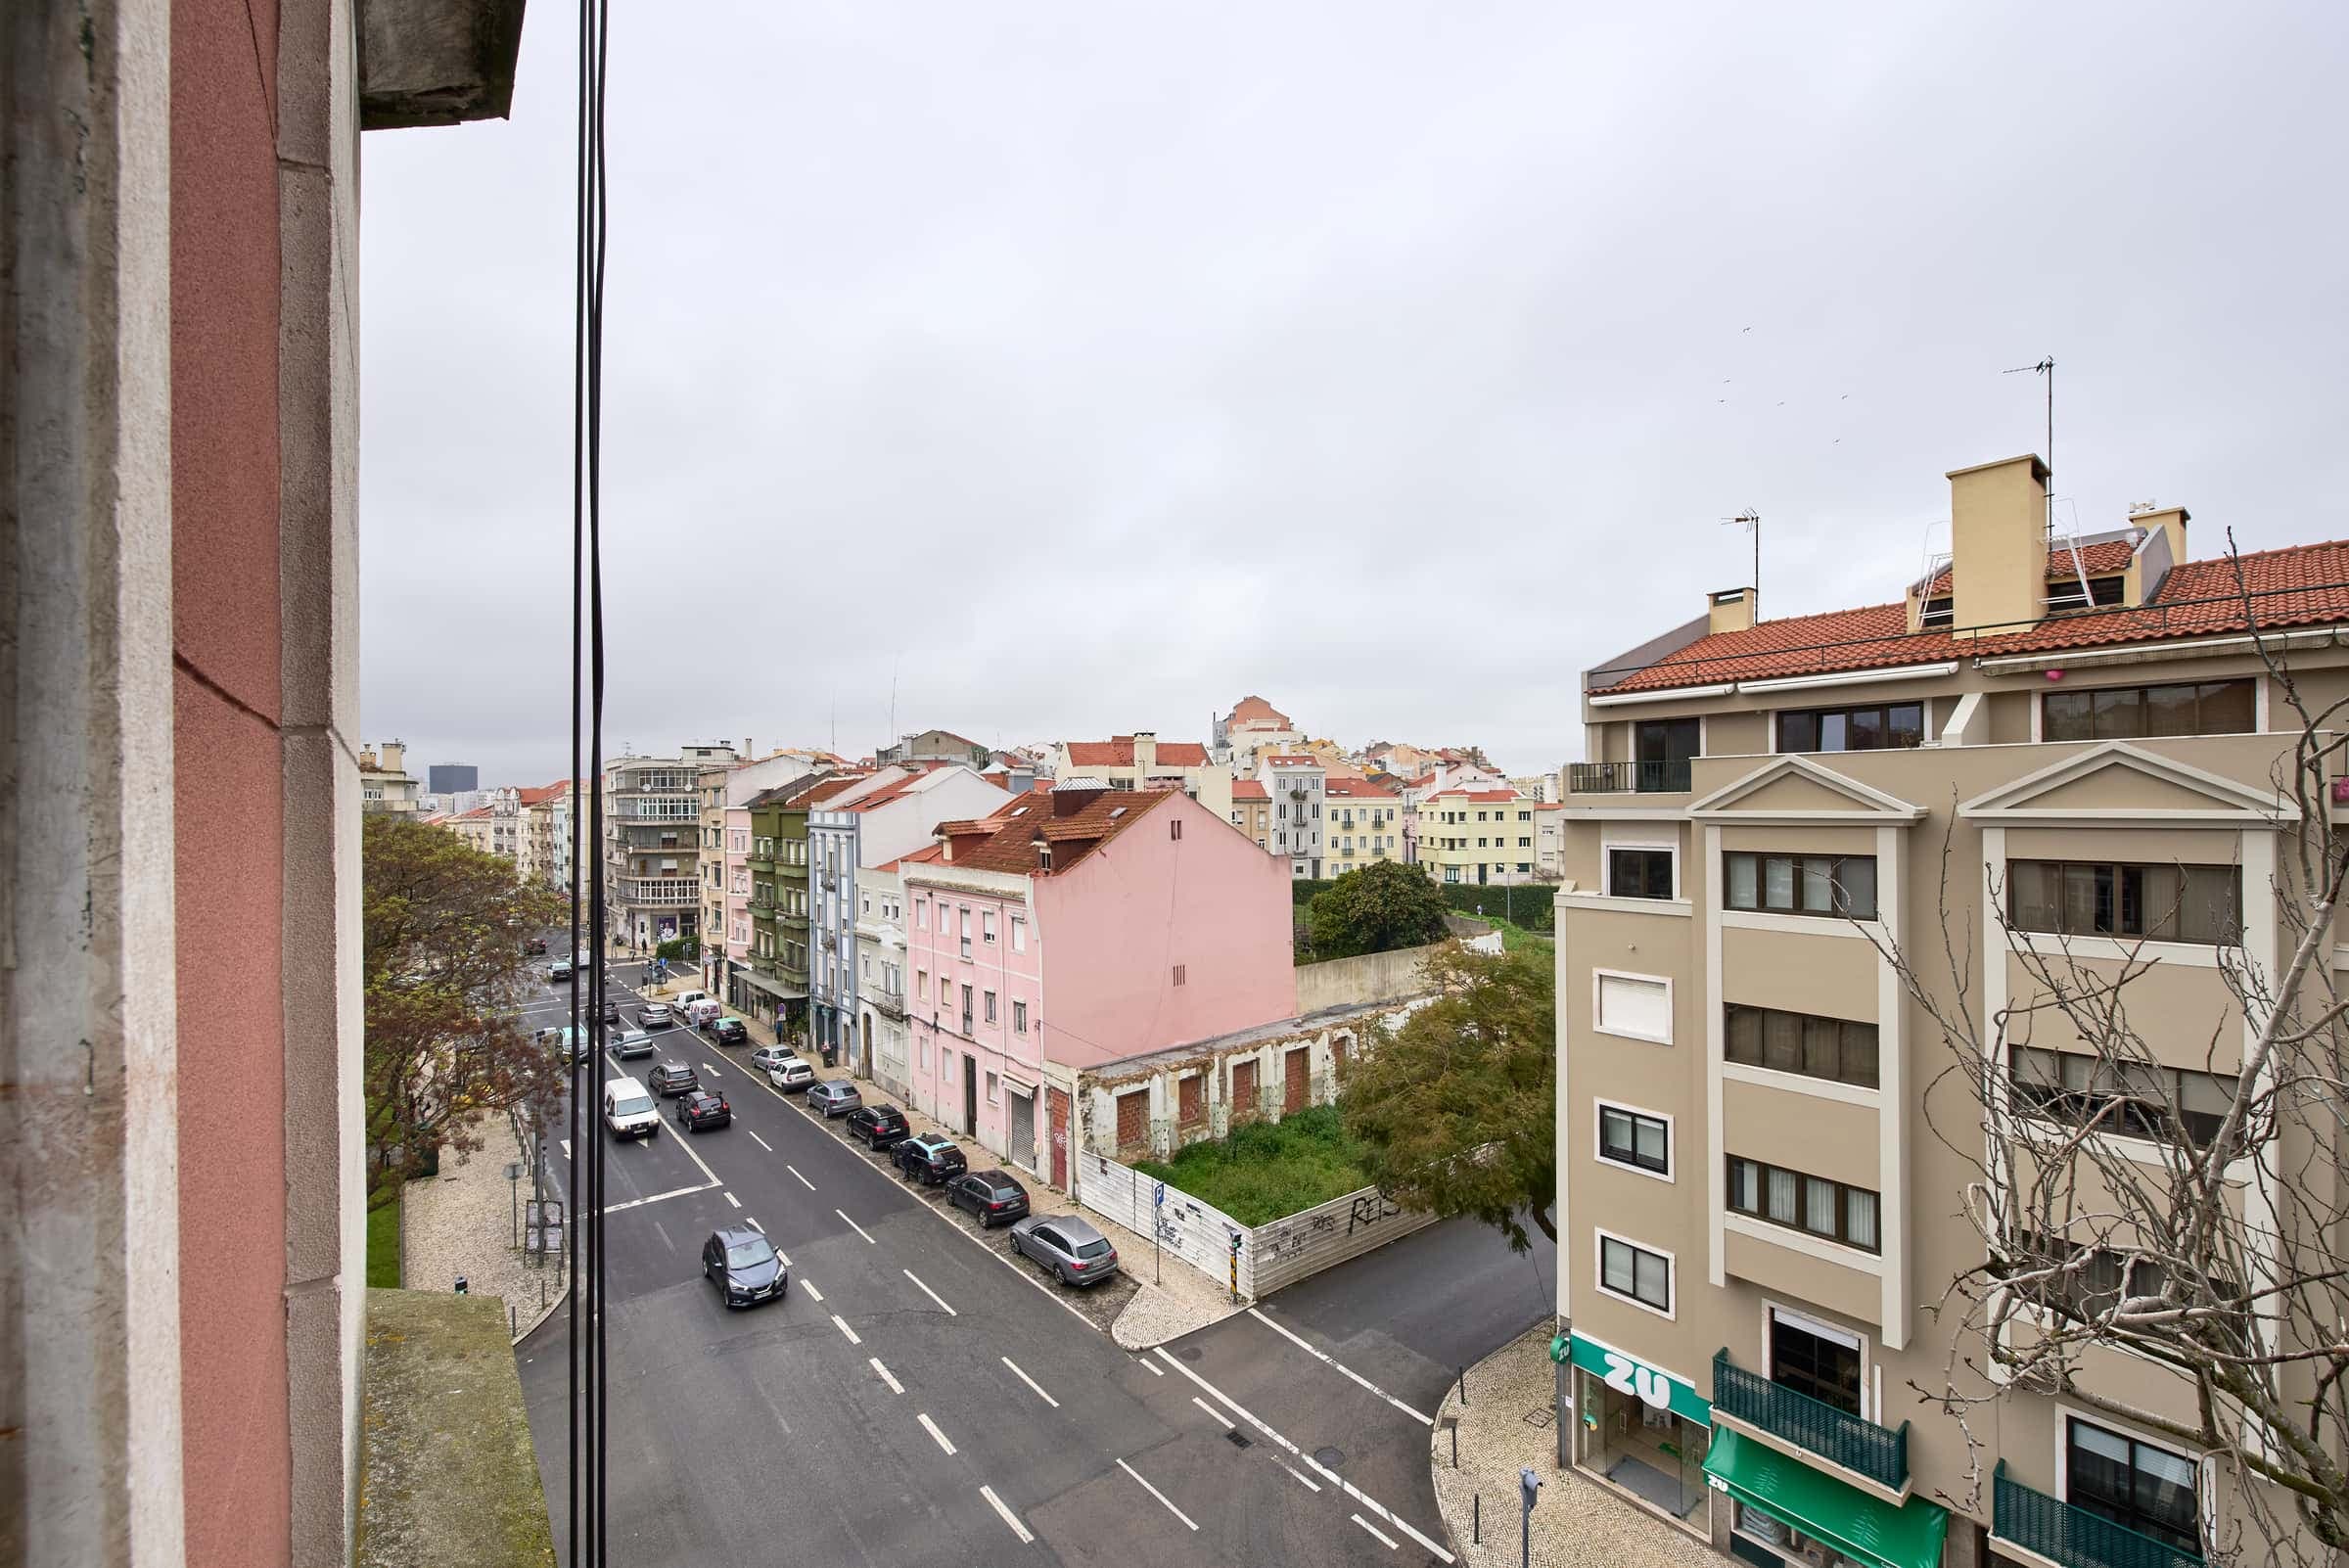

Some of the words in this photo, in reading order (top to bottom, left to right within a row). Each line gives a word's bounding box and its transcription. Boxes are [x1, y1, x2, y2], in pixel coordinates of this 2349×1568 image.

[1156, 1185, 1163, 1206] P
[1558, 1345, 1570, 1361] ZU
[1604, 1353, 1671, 1409] ZU
[1708, 1474, 1728, 1493] ZU
